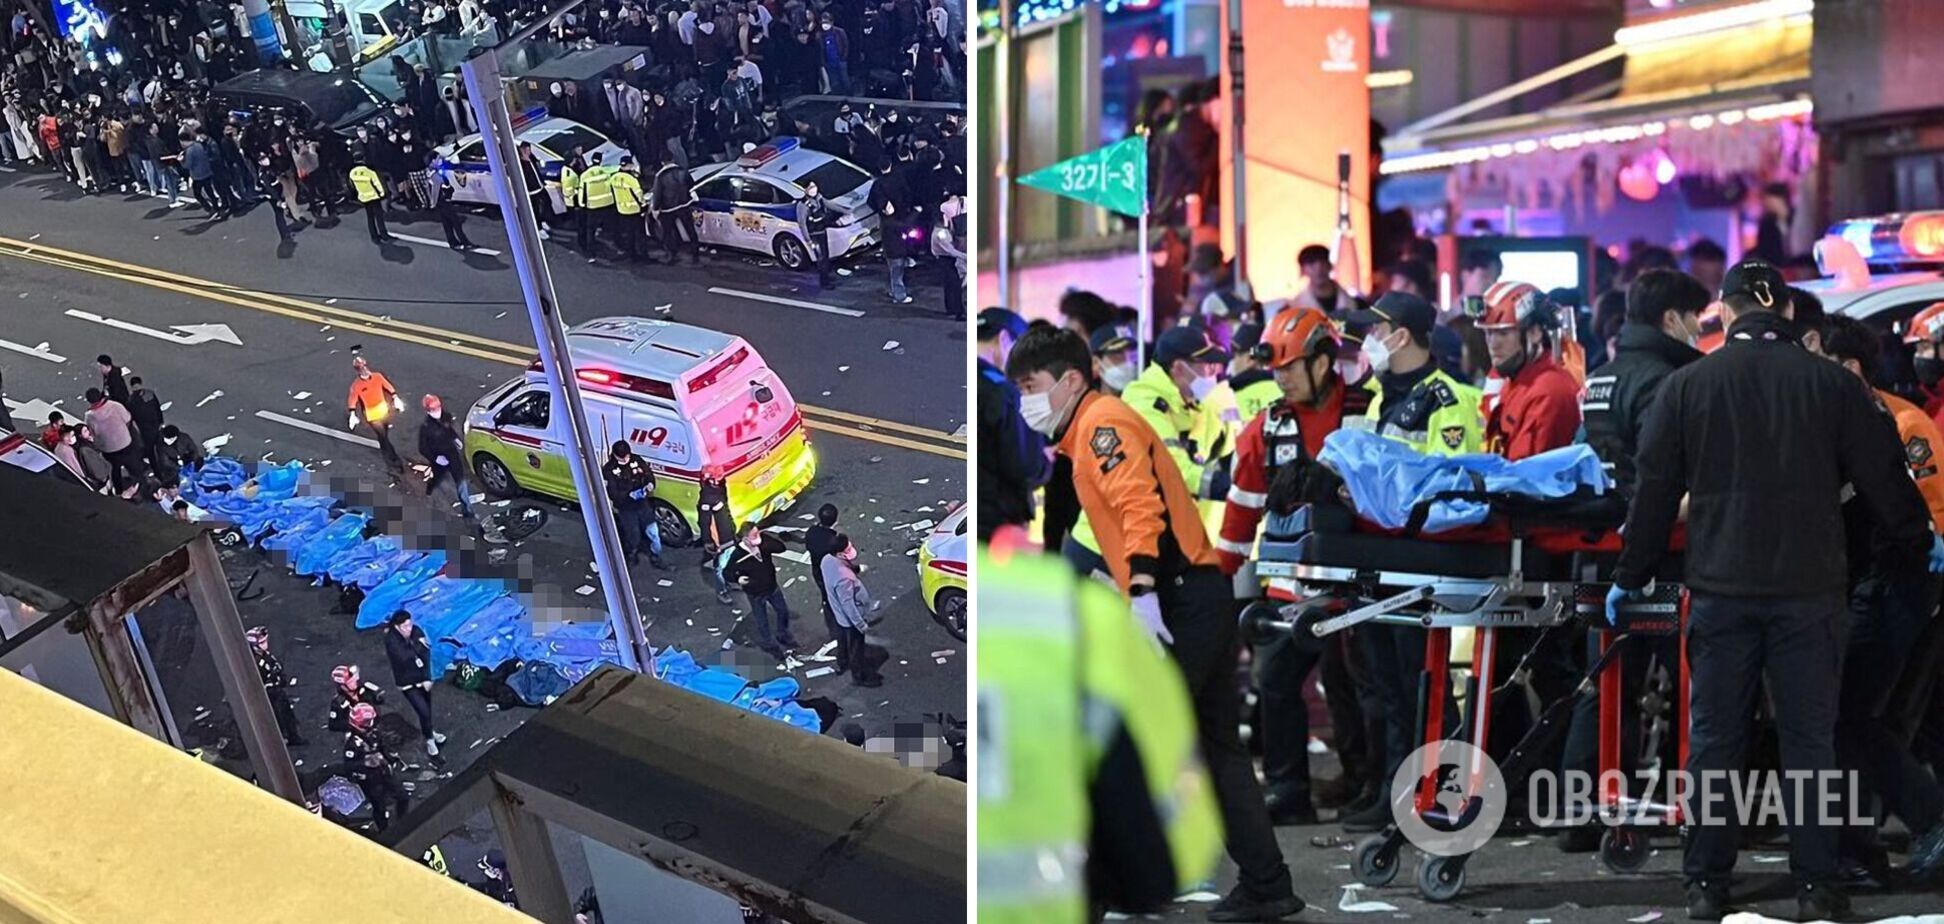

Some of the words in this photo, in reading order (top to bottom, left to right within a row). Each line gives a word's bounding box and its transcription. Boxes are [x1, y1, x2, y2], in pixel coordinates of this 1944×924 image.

[629, 427, 667, 447] 119
[665, 441, 685, 455] 구급대
[726, 402, 758, 446] 119
